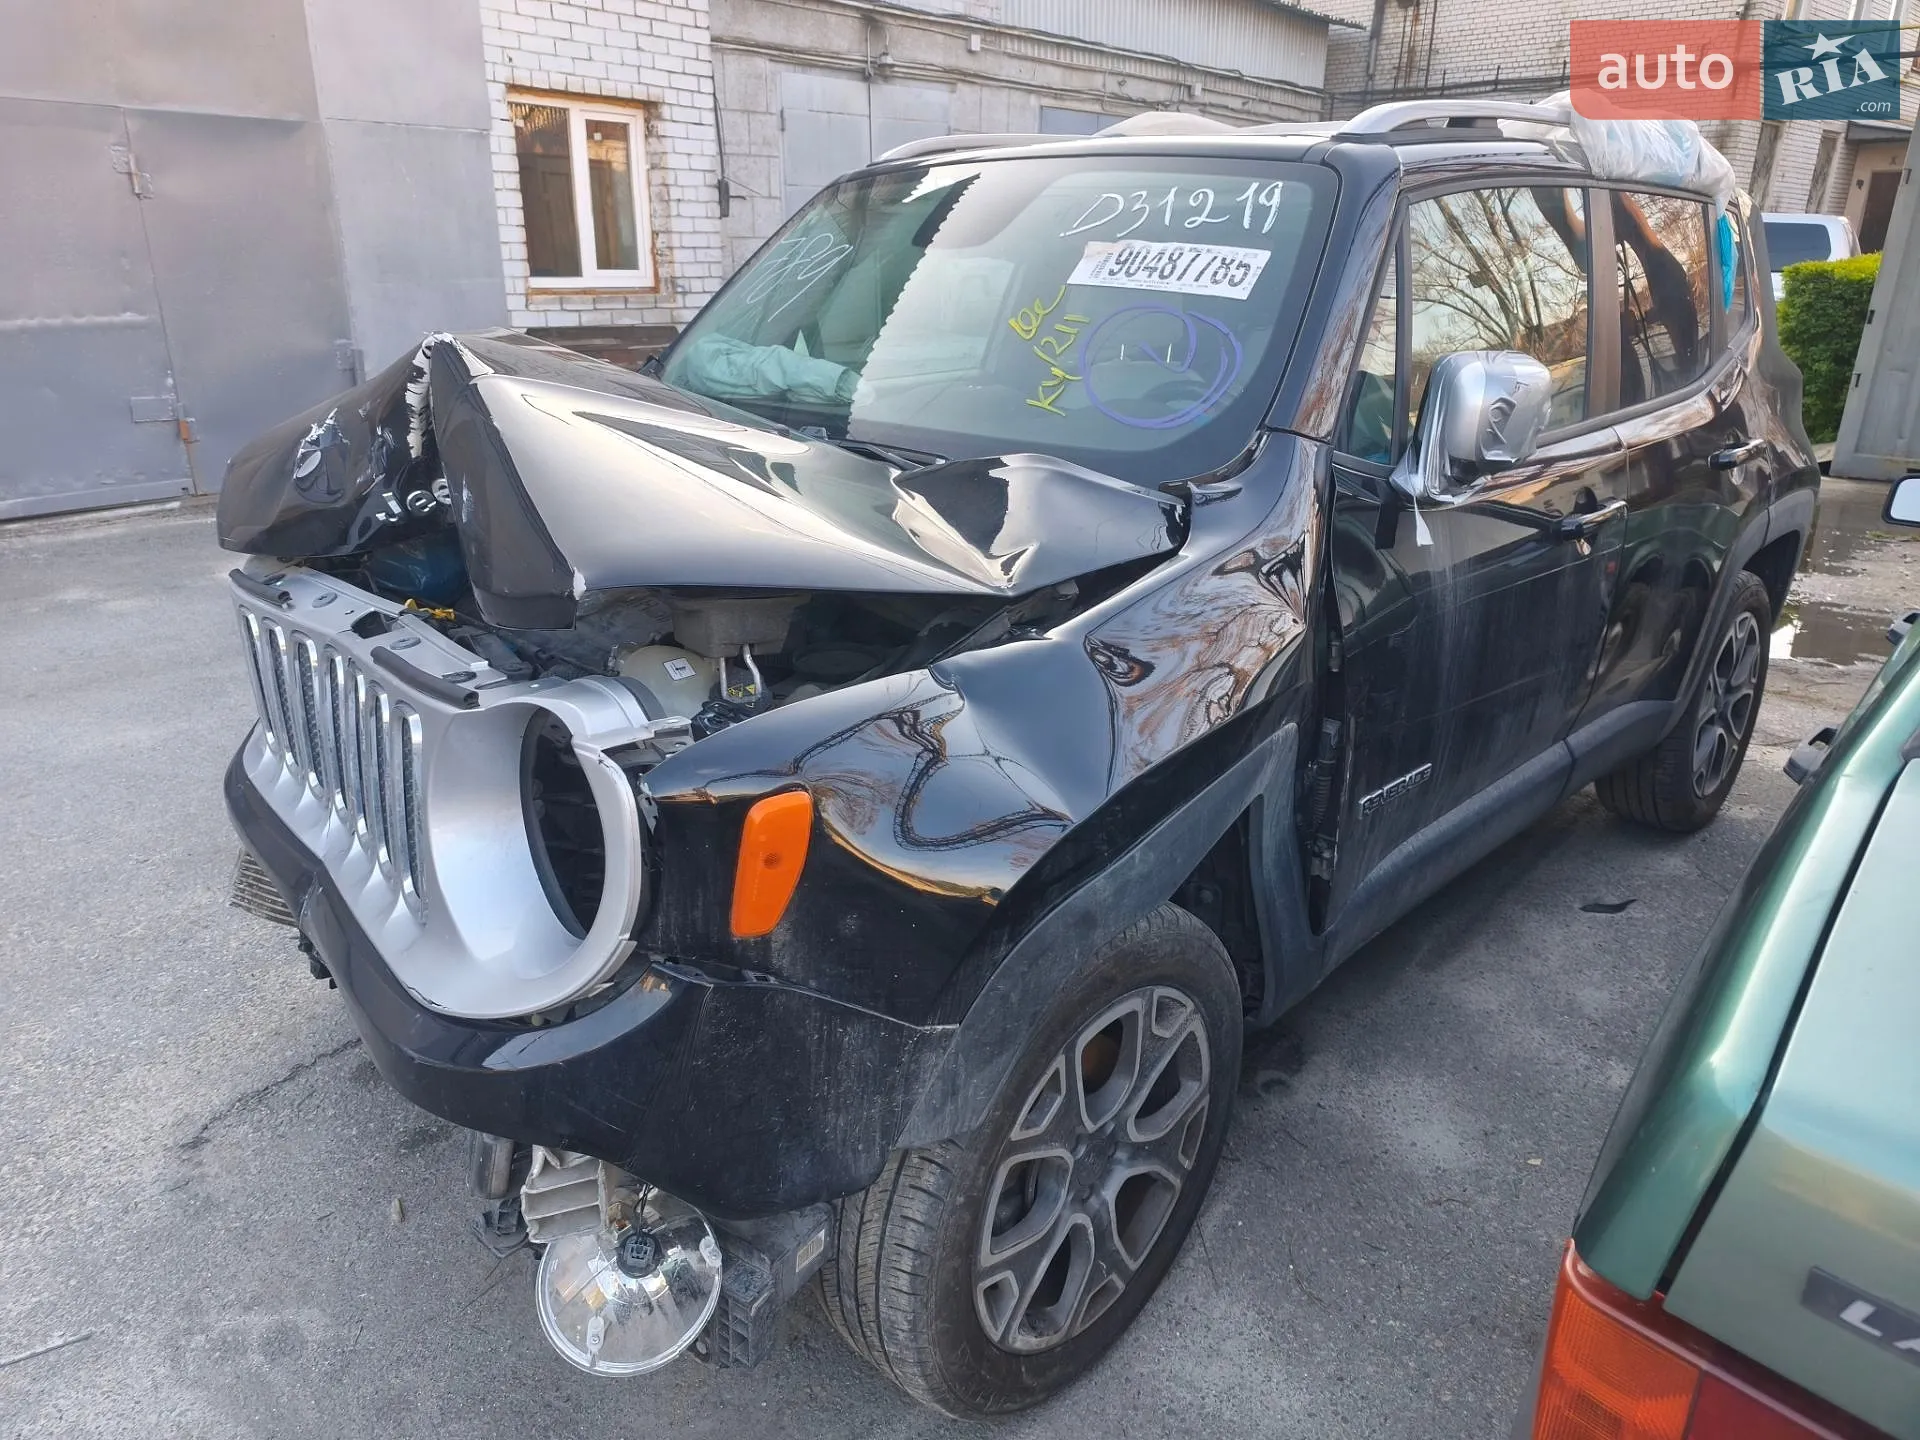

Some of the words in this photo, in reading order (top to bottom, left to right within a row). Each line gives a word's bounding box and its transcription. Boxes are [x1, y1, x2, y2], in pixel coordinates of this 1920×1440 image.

[1059, 180, 1284, 238] D31219
[1107, 245, 1252, 288] 90487785
[375, 477, 452, 522] Jee
